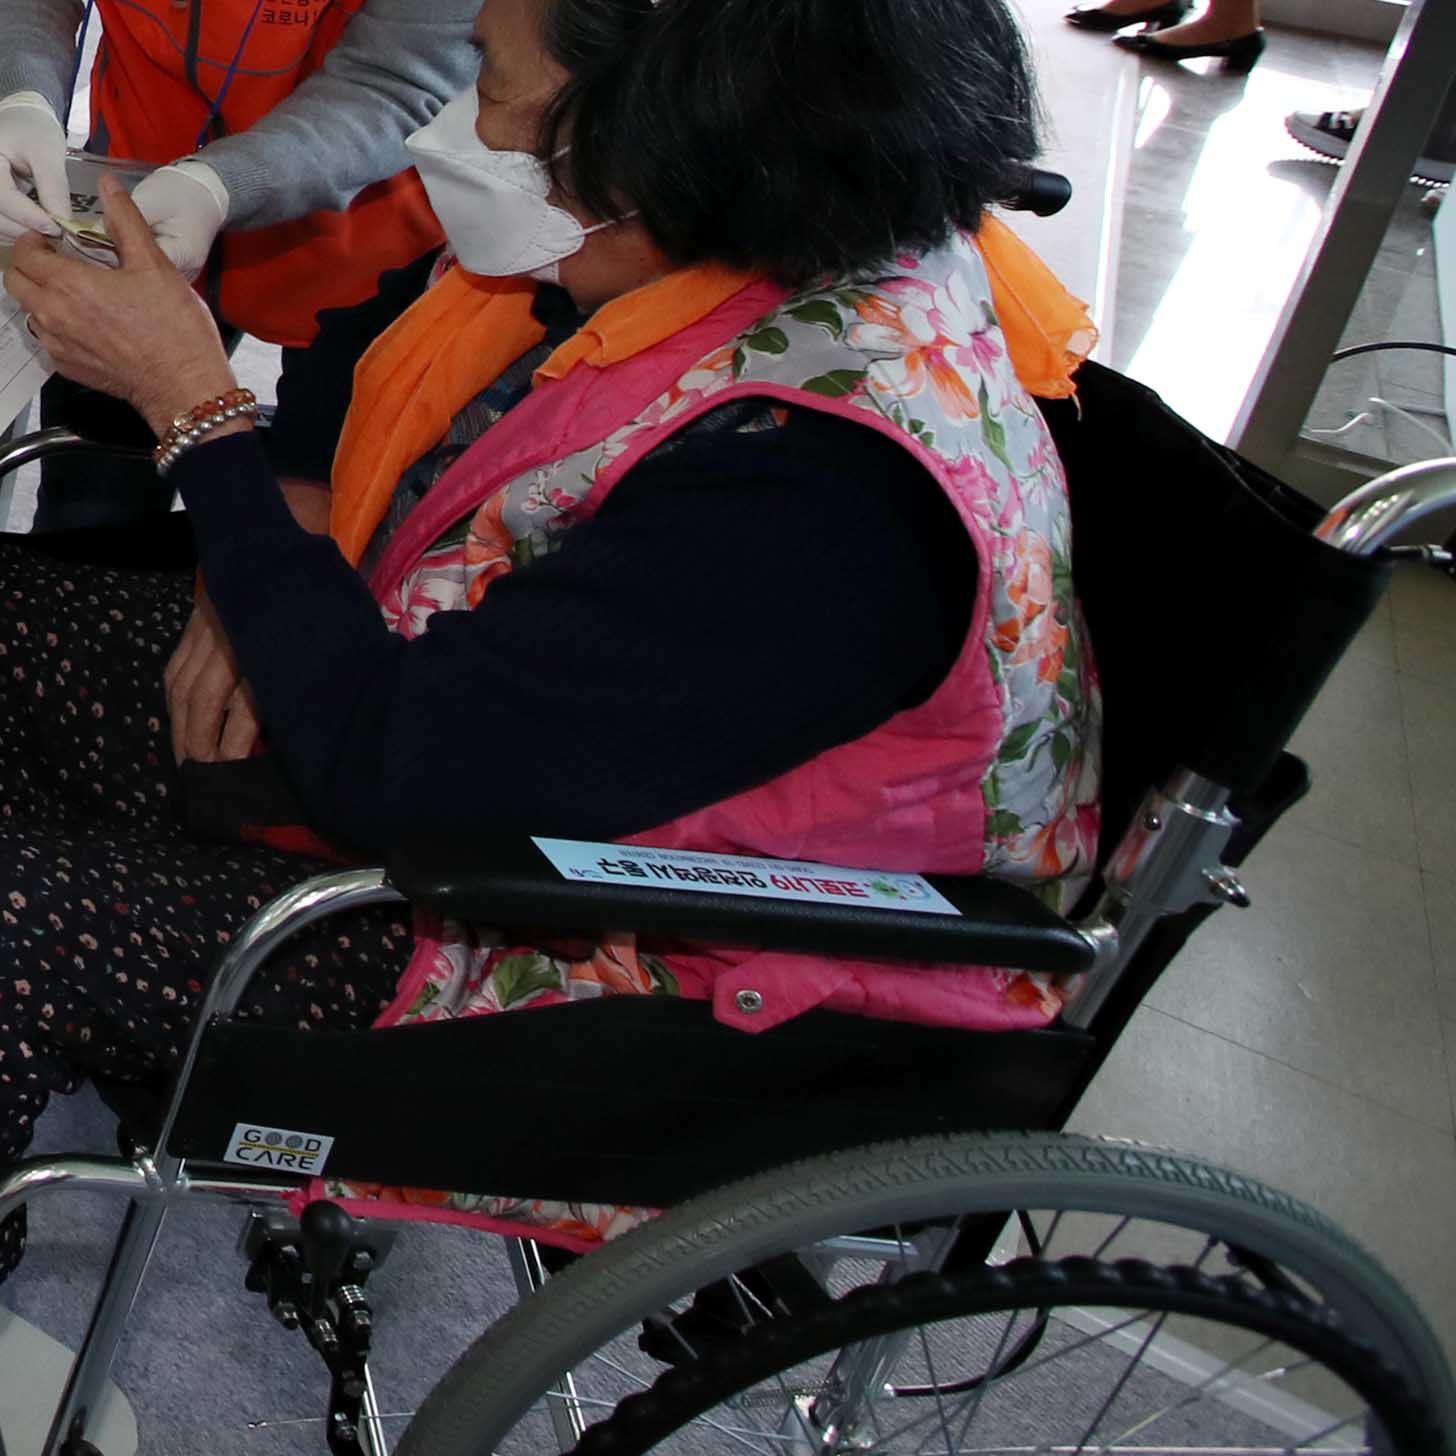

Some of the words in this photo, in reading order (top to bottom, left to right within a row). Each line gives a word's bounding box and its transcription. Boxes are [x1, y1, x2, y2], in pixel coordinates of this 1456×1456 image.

[596, 856, 645, 878] 동구
[645, 862, 768, 890] 인천광역시
[770, 874, 867, 899] 코로나19
[235, 1147, 317, 1170] CARE
